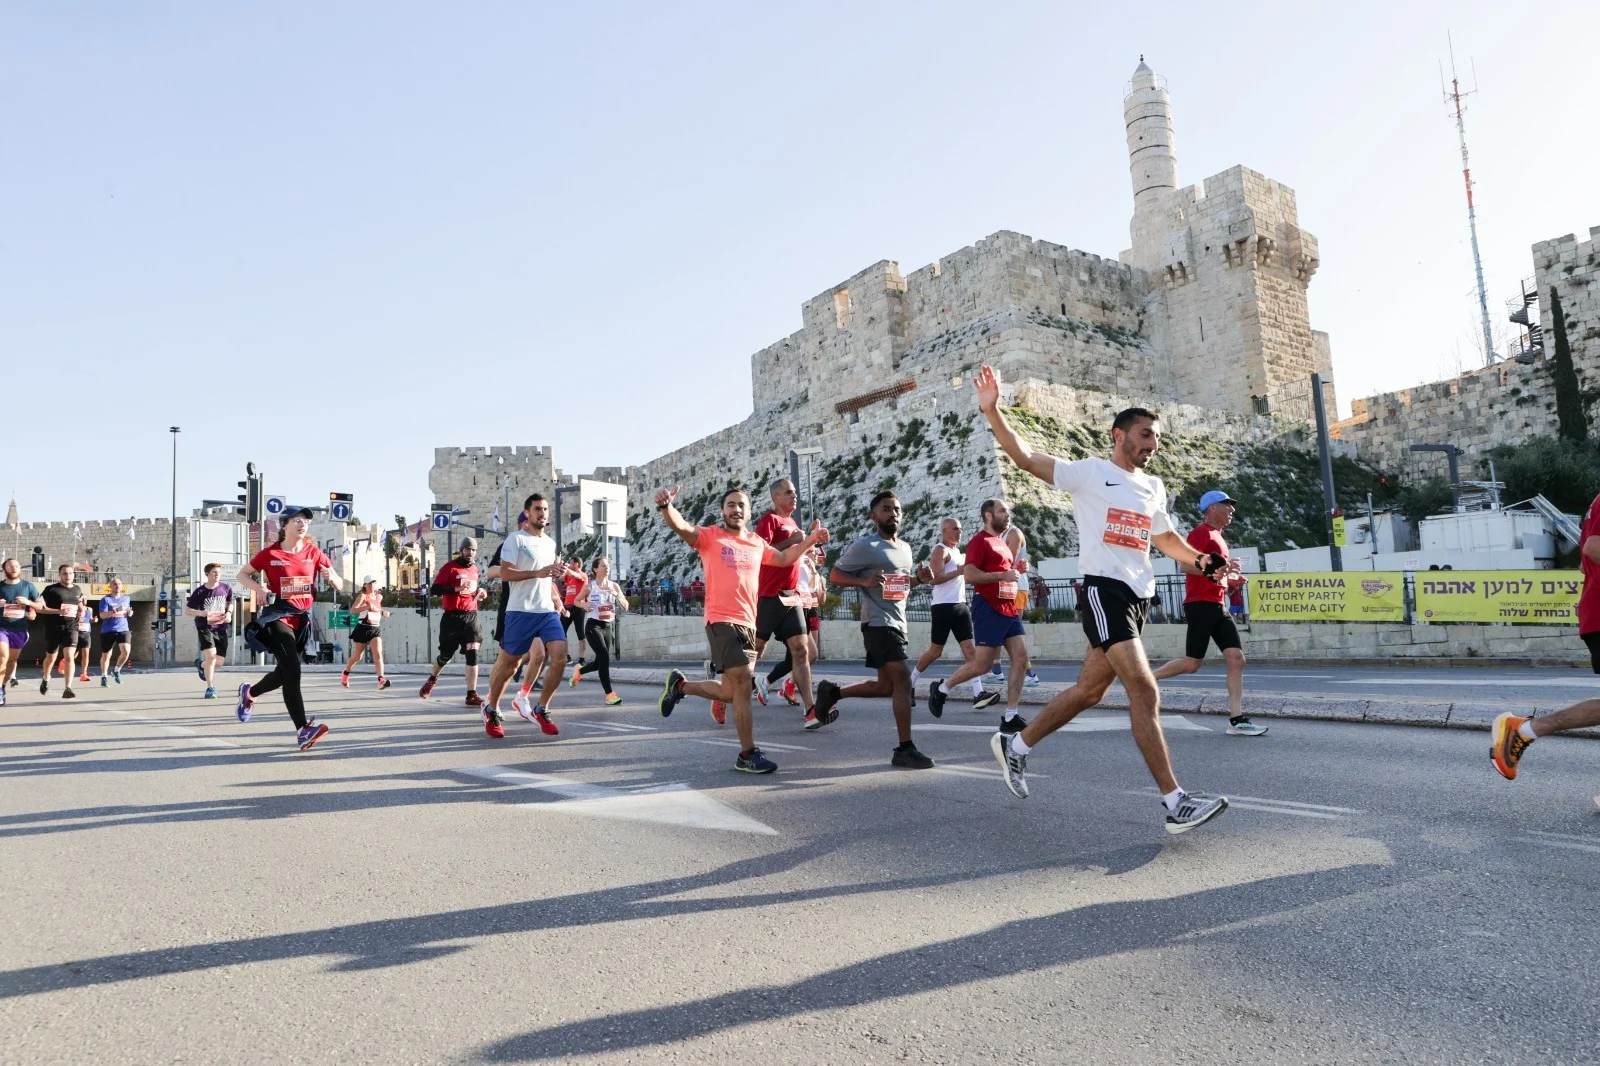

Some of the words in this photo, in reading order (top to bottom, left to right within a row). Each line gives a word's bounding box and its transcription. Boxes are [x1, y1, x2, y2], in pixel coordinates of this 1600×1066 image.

[1257, 579, 1292, 589] TEAM
[1295, 578, 1346, 588] SHALVA
[1423, 580, 1476, 594] אהבה
[1483, 578, 1533, 599] למען
[1258, 592, 1305, 601] VICTORY
[1308, 591, 1346, 600] PARTY
[1258, 604, 1271, 613] AT
[1274, 604, 1317, 613] CINEMA
[1319, 603, 1346, 613] CITY
[1499, 607, 1529, 617] שלוה
[1534, 608, 1571, 617] נבחרת
